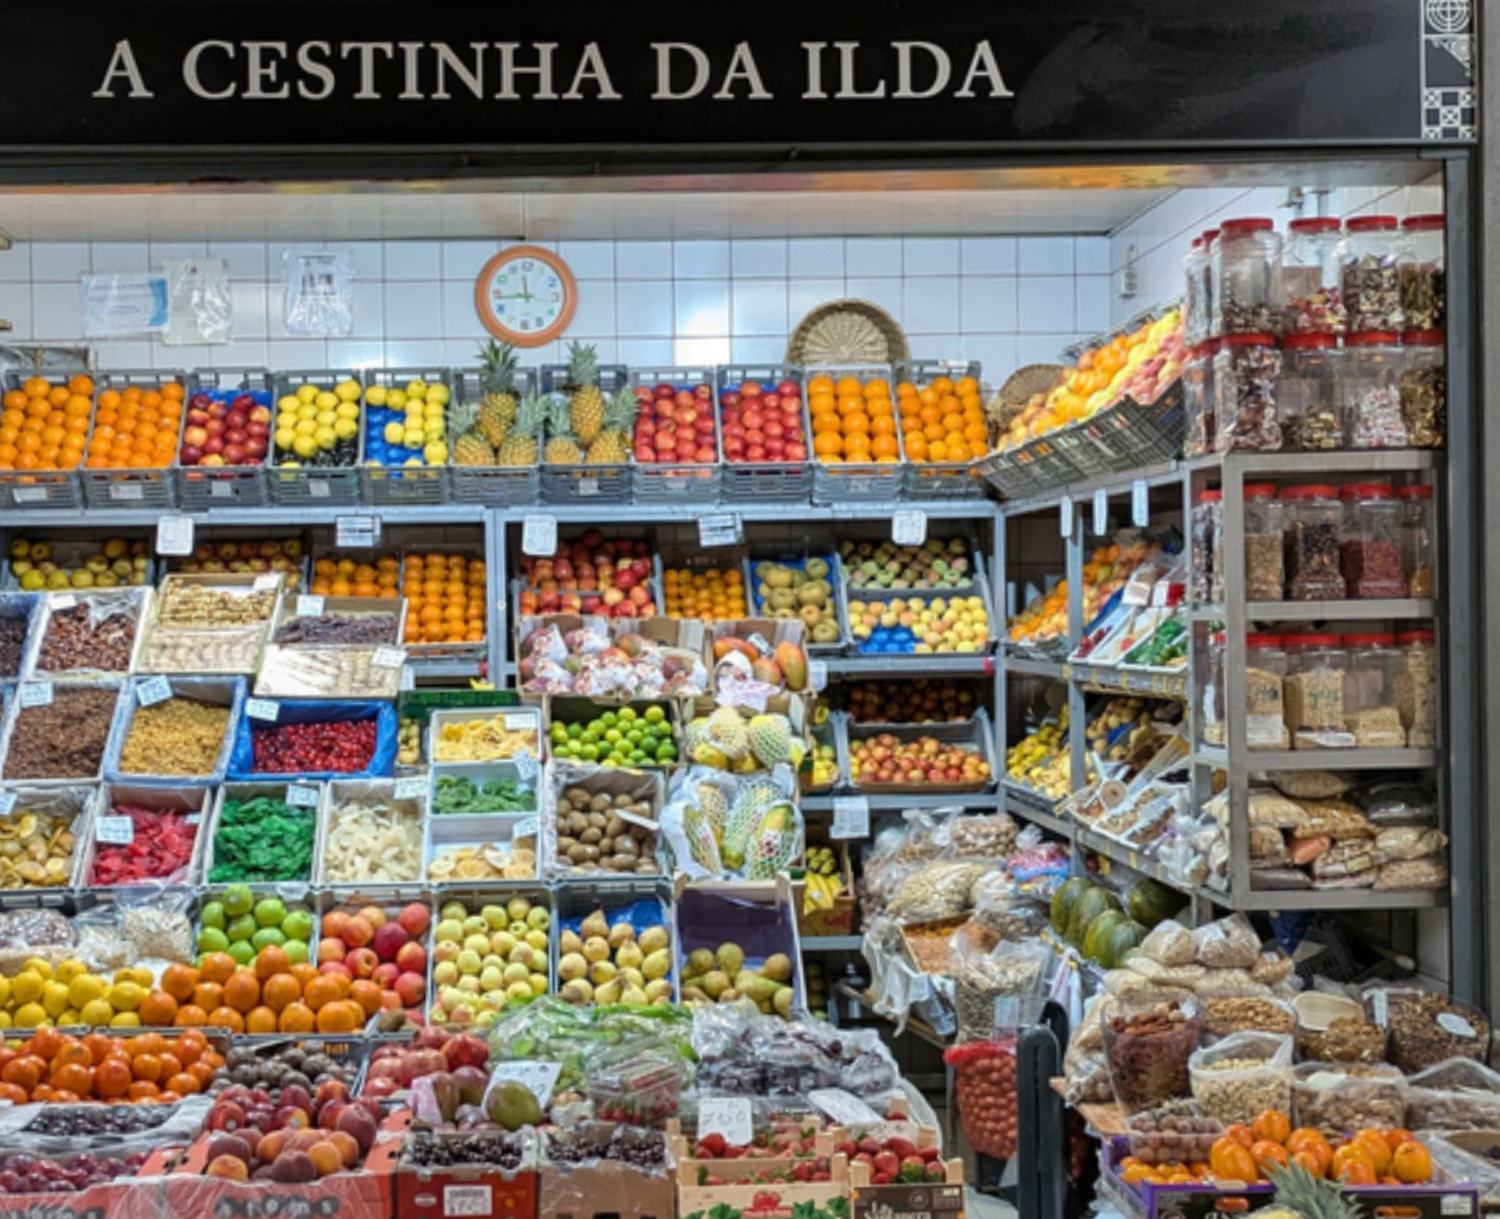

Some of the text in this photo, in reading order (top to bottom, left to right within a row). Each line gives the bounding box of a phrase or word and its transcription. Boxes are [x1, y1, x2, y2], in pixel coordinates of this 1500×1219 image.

[94, 40, 1014, 99] A CESTINHA DA ILDA
